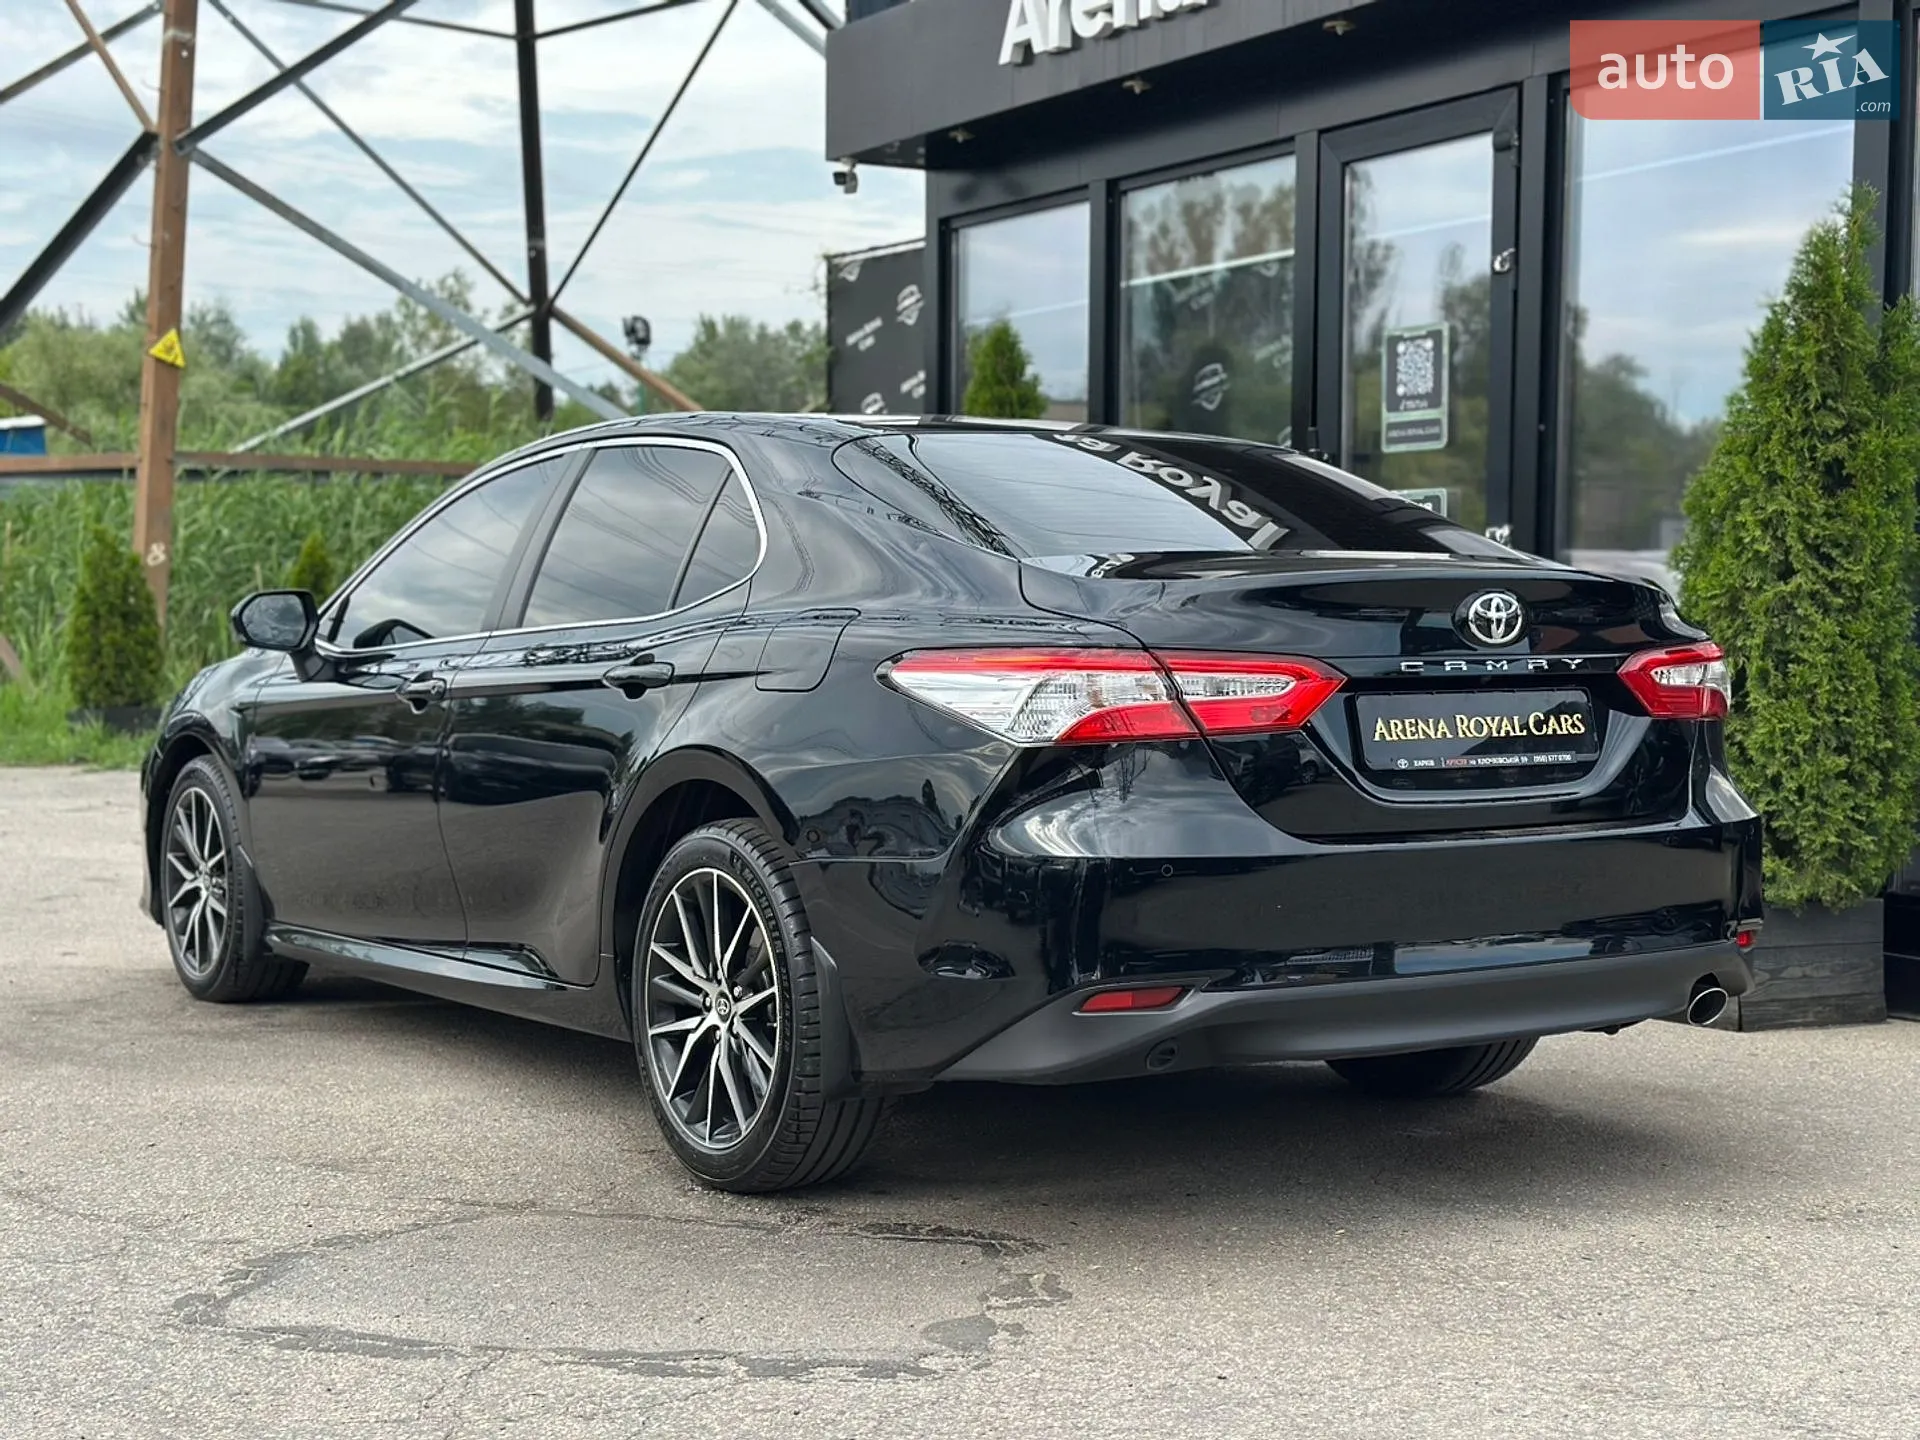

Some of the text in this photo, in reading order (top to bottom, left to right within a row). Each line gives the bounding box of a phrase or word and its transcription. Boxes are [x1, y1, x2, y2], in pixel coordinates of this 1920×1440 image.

[1401, 658, 1584, 672] CAMRY
[1373, 711, 1586, 742] ARENA ROYAL CARS
